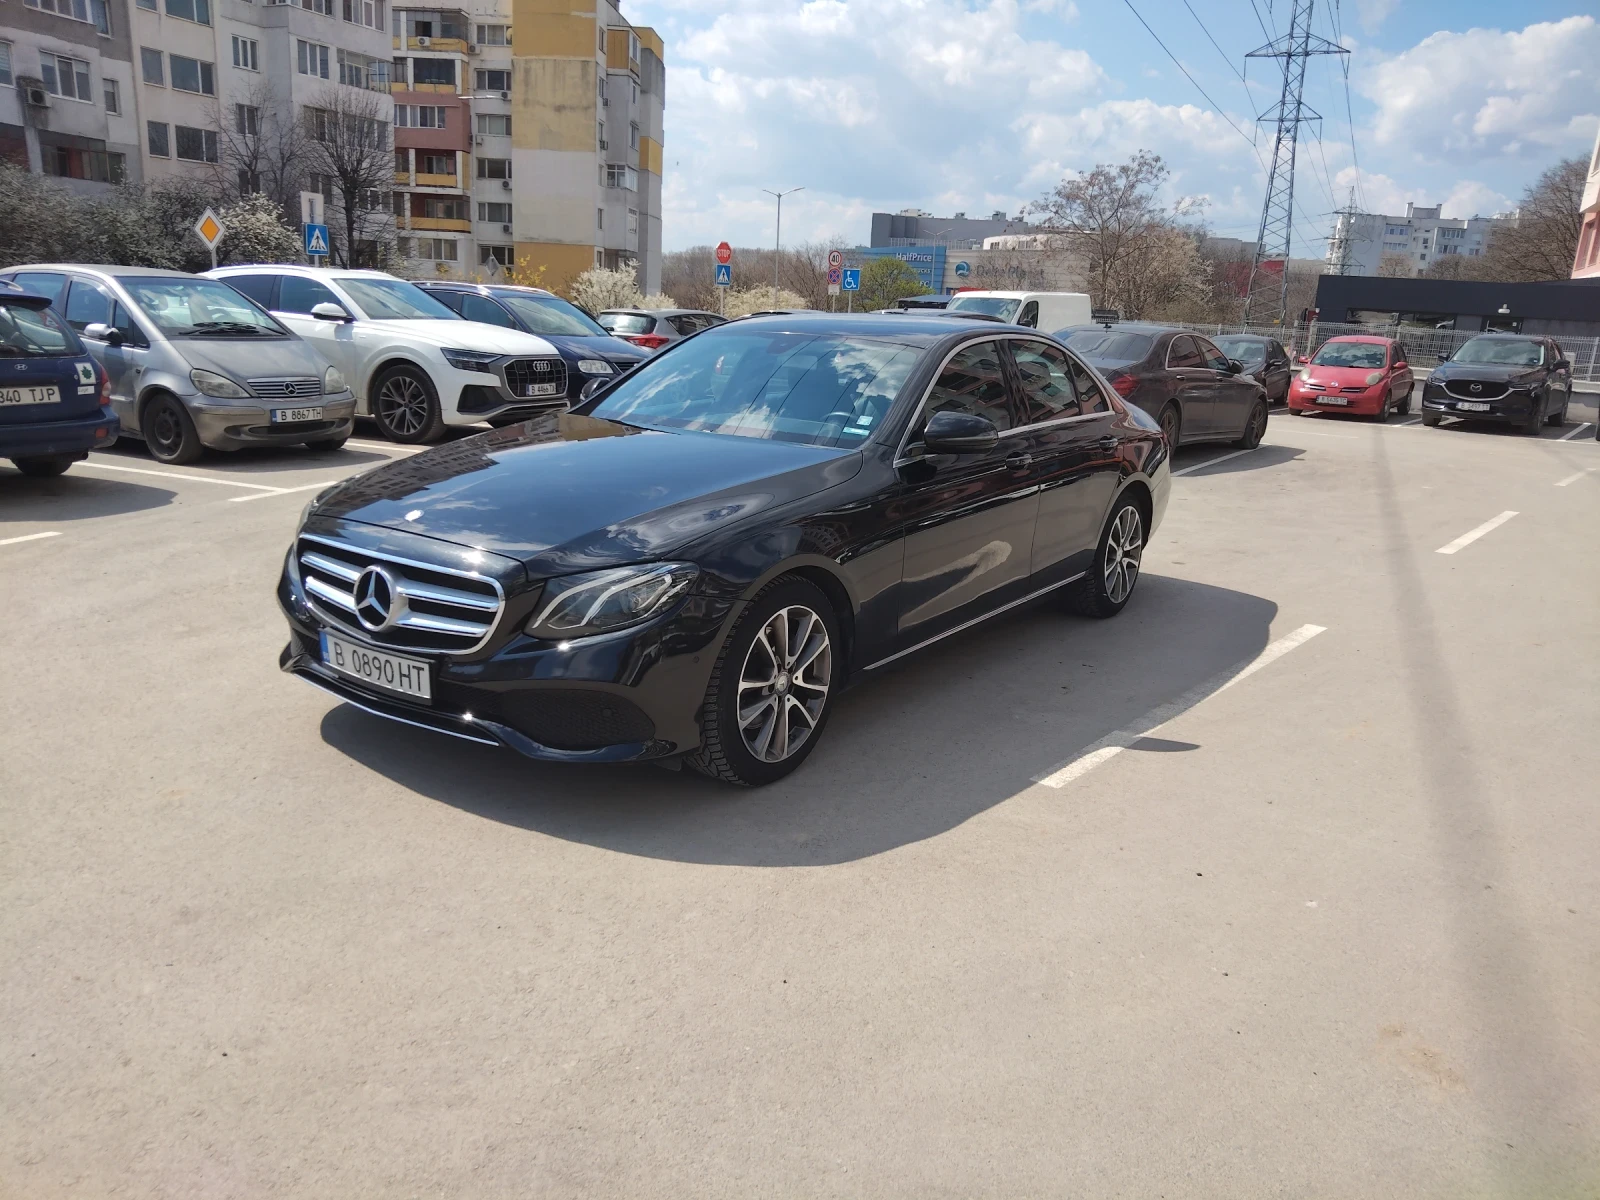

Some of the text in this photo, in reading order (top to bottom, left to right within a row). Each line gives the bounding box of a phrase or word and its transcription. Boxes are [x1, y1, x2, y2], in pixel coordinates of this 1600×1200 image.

[718, 249, 731, 258] STOP
[896, 252, 932, 262] HalfPrice
[831, 254, 840, 264] 40
[28, 387, 55, 402] TJP
[281, 410, 287, 420] B
[291, 409, 310, 420] 8867
[333, 641, 425, 692] B 0890 HT
